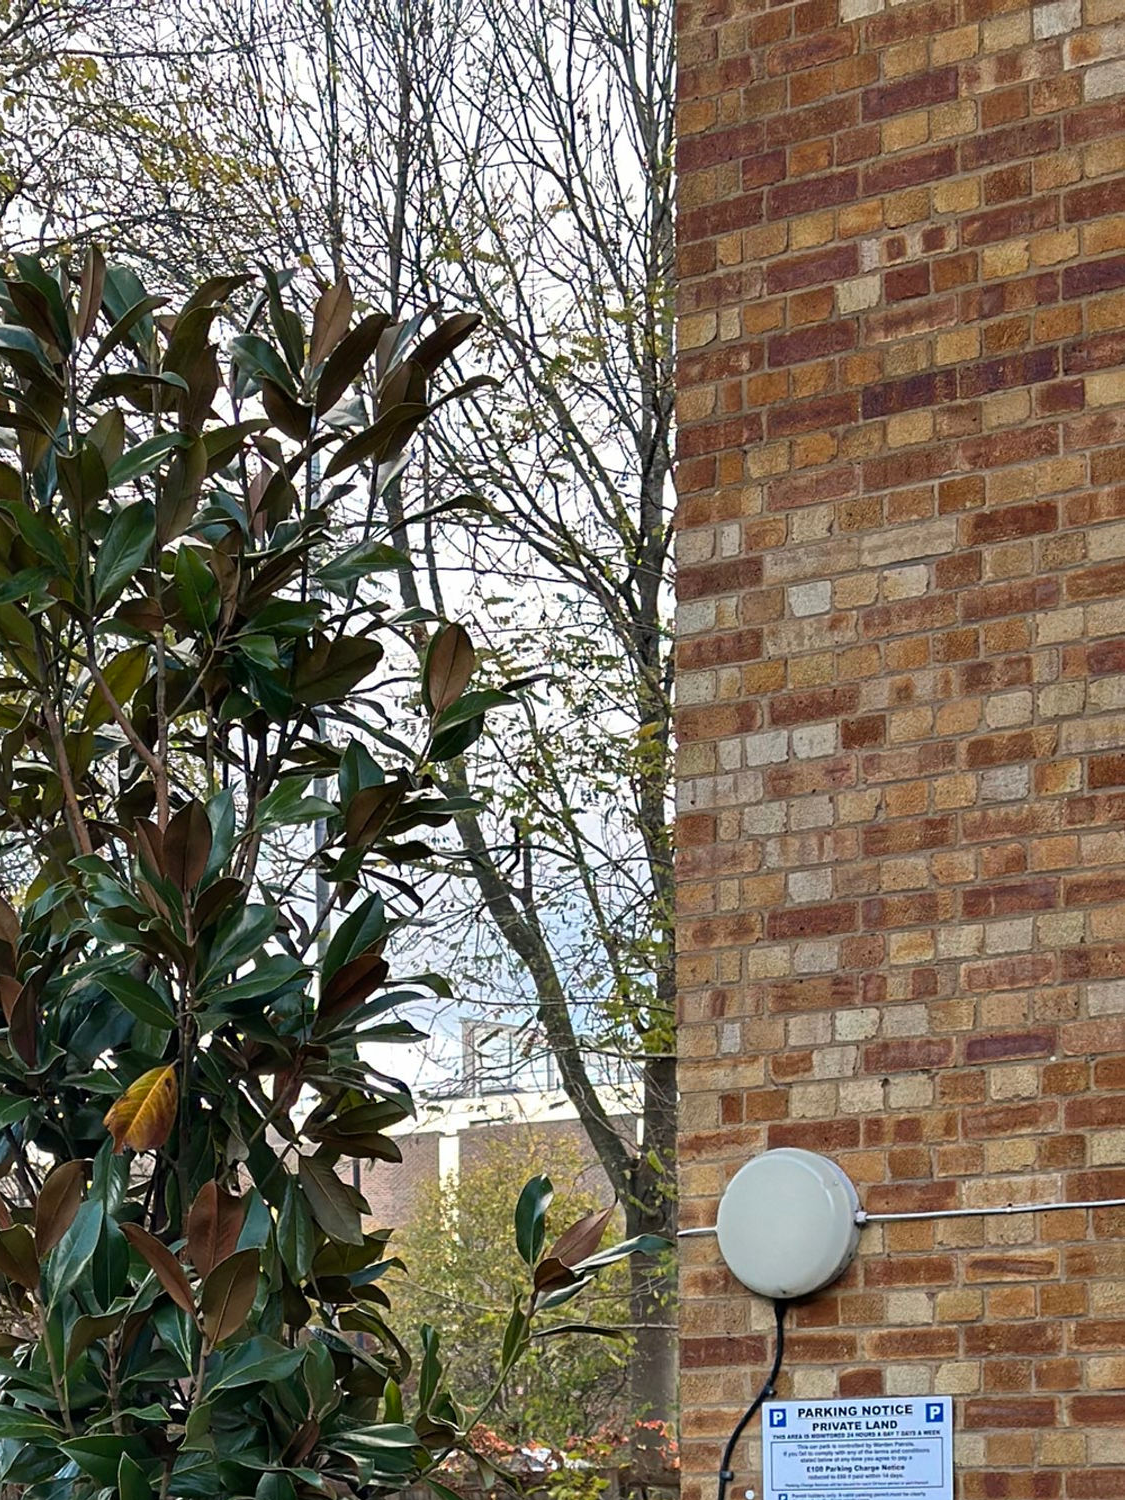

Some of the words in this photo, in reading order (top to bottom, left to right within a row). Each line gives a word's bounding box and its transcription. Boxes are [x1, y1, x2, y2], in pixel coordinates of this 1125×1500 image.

[798, 1407, 857, 1417] PARKING
[862, 1405, 913, 1415] NOTICE
[813, 1421, 862, 1431] PRIVATE
[866, 1420, 898, 1429] LAND
[825, 1465, 852, 1473] Parking
